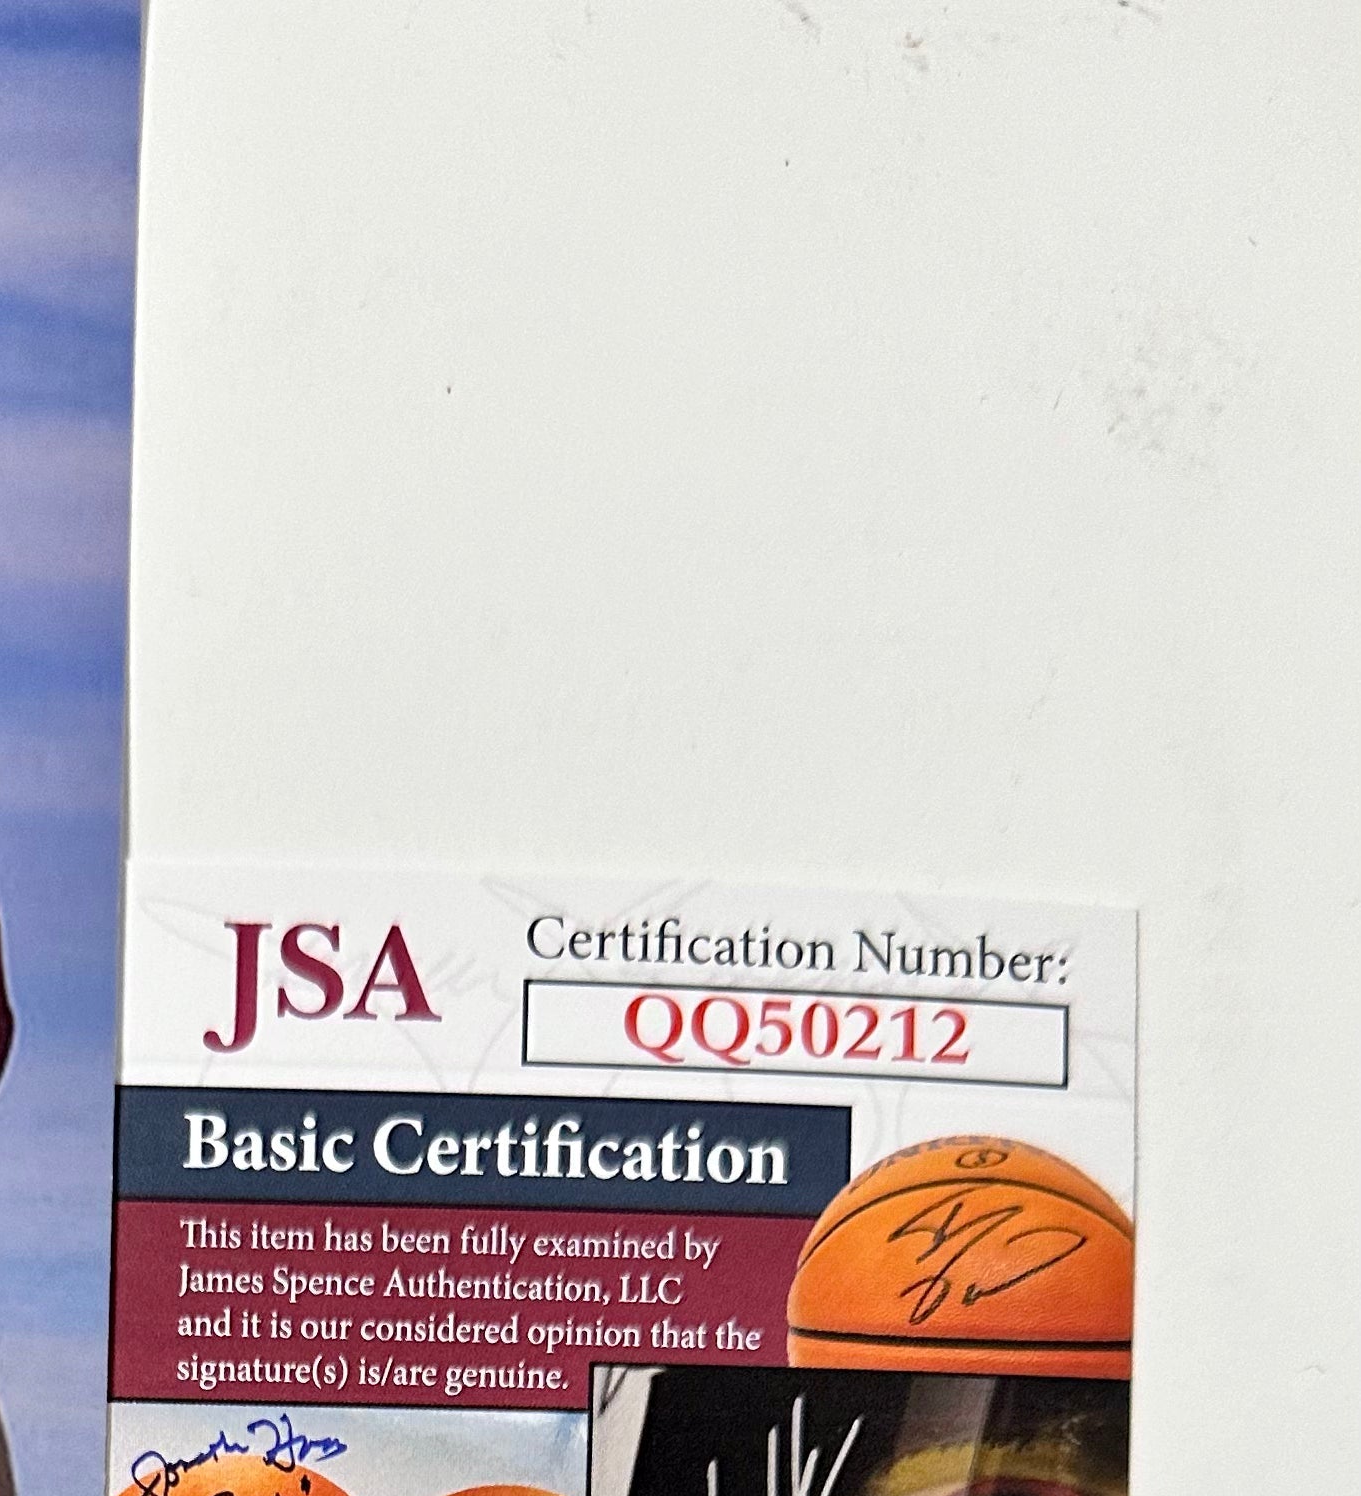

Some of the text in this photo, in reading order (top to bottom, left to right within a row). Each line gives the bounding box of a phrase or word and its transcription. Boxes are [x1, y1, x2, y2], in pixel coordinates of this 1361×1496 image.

[526, 914, 1069, 987] Certification Number:
[202, 921, 443, 1054] JSA
[622, 993, 972, 1066] QQ50212
[183, 1111, 355, 1174] Basic
[372, 1115, 788, 1187] Certification
[180, 1217, 720, 1269] This item has been fully examined by
[179, 1263, 683, 1306] James Spence Authentication, LLC
[177, 1307, 763, 1353] and it is our considered opinion that the
[176, 1353, 570, 1397] signature(s) is/are genuine.
